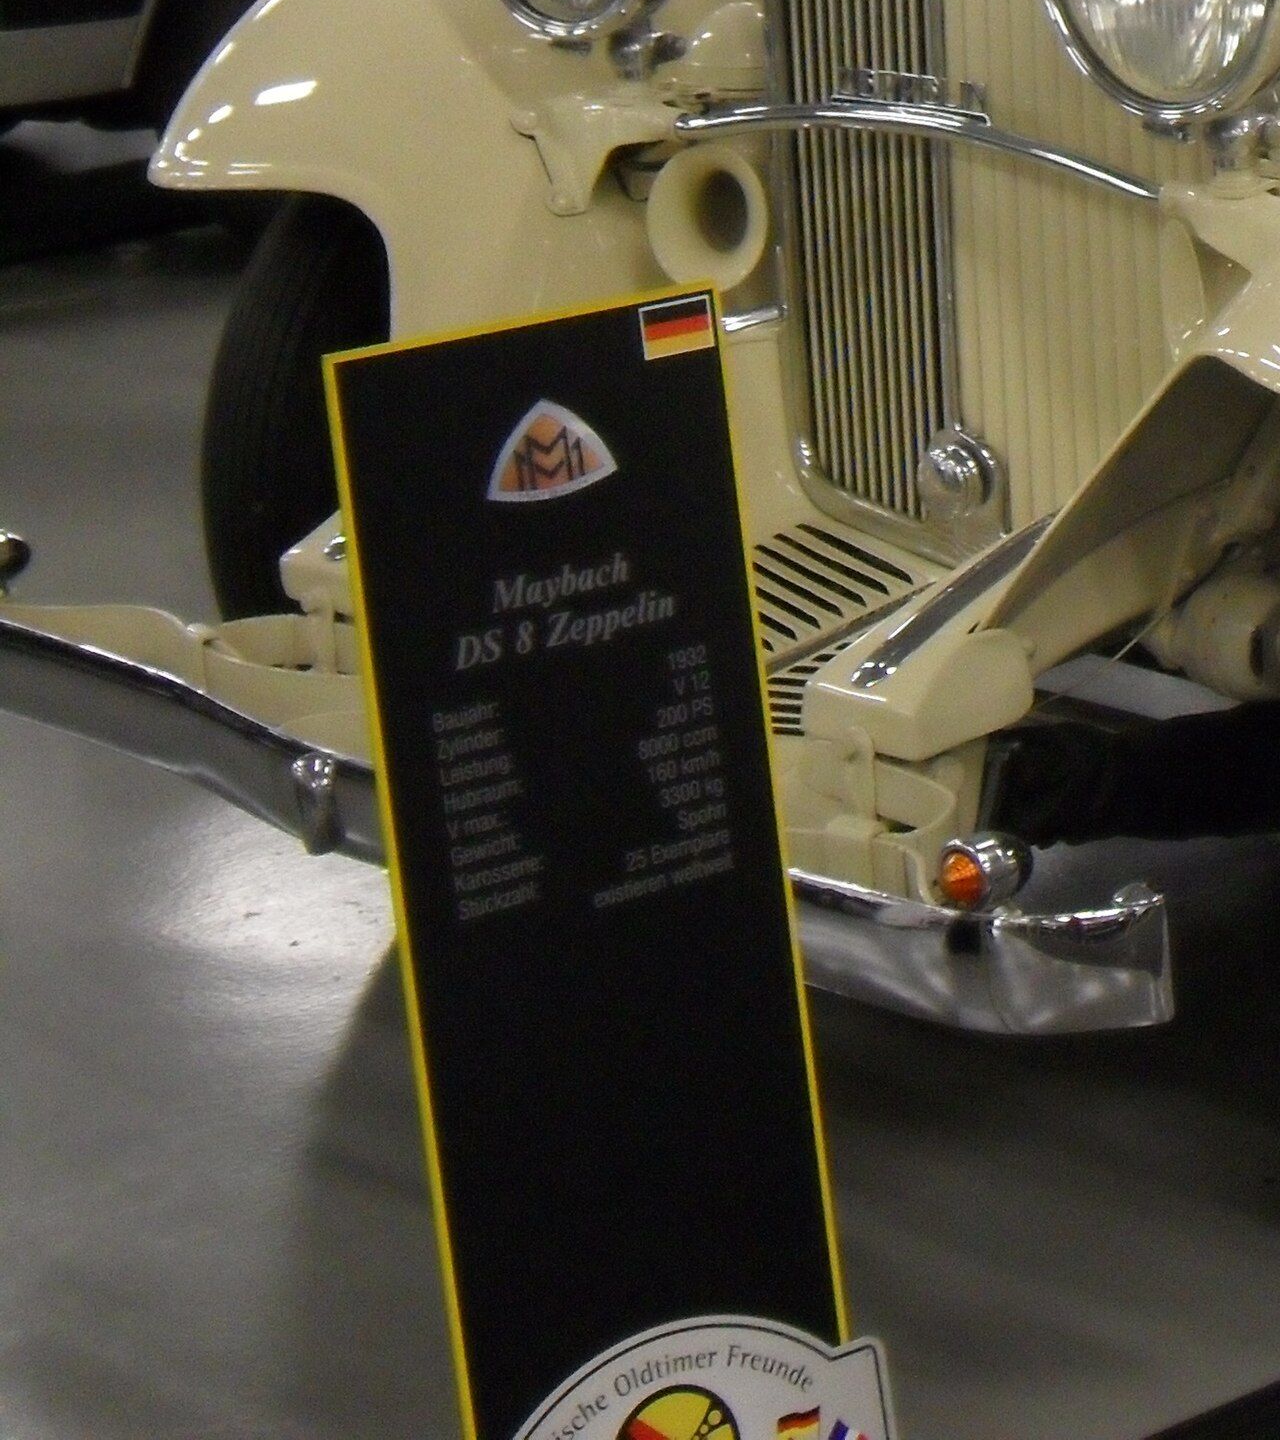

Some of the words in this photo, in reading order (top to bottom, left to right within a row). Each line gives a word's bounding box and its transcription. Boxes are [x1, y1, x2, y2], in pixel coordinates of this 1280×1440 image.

[493, 552, 629, 613] Maybach
[456, 628, 502, 671] DS
[515, 620, 535, 655] 8
[546, 590, 674, 648] Zeppelin
[667, 644, 706, 670] 1932
[672, 675, 686, 696] V
[693, 670, 711, 691] 12
[432, 701, 502, 734] Baujahr:
[656, 703, 688, 729] 200
[691, 695, 714, 719] PS
[437, 728, 505, 763] Zylinder:
[638, 732, 679, 761] 8000
[682, 725, 719, 749] ccm
[440, 752, 515, 788] Leistung:
[648, 760, 678, 784] 160
[681, 748, 721, 775] km/h
[443, 778, 525, 816] Hubraum:
[659, 780, 700, 809] 3300
[705, 777, 724, 800] kg
[447, 819, 460, 841] V
[677, 803, 727, 833] Spohn
[450, 831, 523, 867] Gewicht:
[626, 848, 648, 872] 25
[650, 828, 731, 865] Exemplare
[454, 855, 545, 893] Karosserie:
[593, 873, 667, 908] existieren
[458, 881, 541, 922] Stückzahl:
[613, 1348, 719, 1397] Oldtimer
[726, 1344, 814, 1394] Freunde
